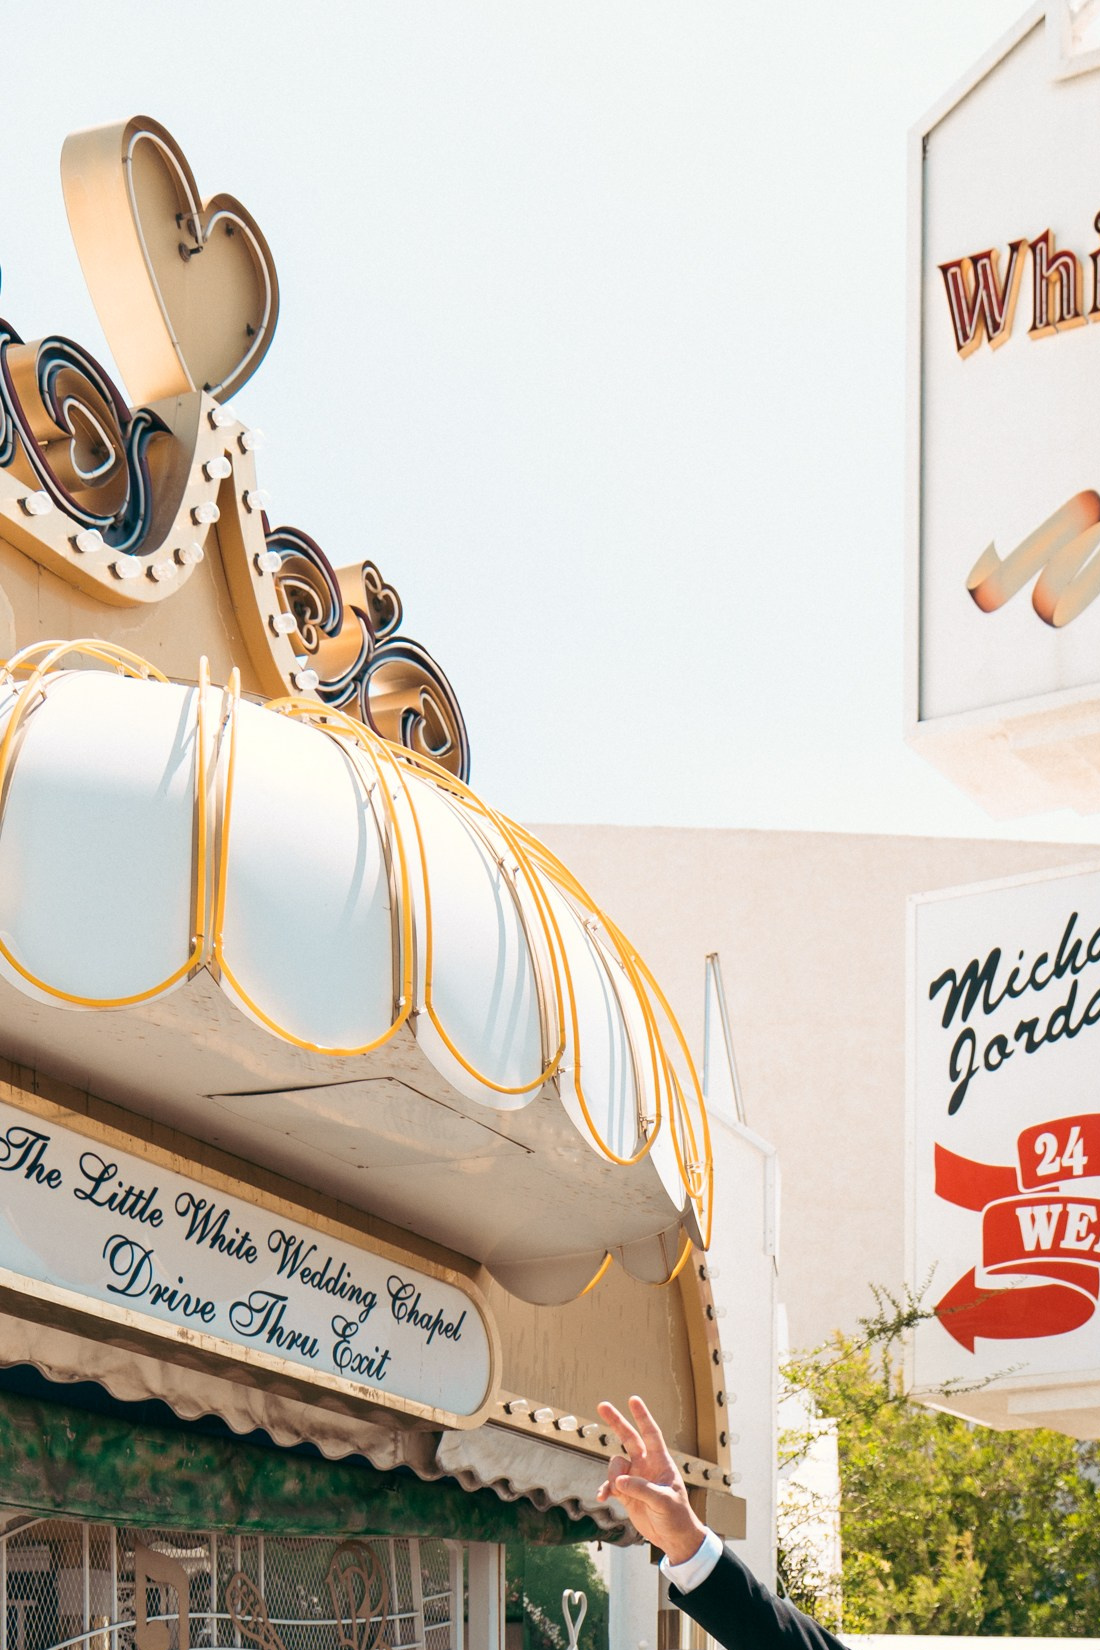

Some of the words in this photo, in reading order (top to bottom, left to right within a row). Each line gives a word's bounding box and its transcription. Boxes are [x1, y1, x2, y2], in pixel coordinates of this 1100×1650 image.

[1034, 1126, 1088, 1177] 24
[0, 1126, 63, 1189] The
[73, 1152, 164, 1228] Little
[174, 1192, 259, 1264] White
[267, 1229, 378, 1323] Wedding
[386, 1275, 468, 1345] Chapel
[102, 1233, 216, 1324] Drive
[228, 1290, 320, 1359] Thru
[331, 1314, 392, 1382] Exit
